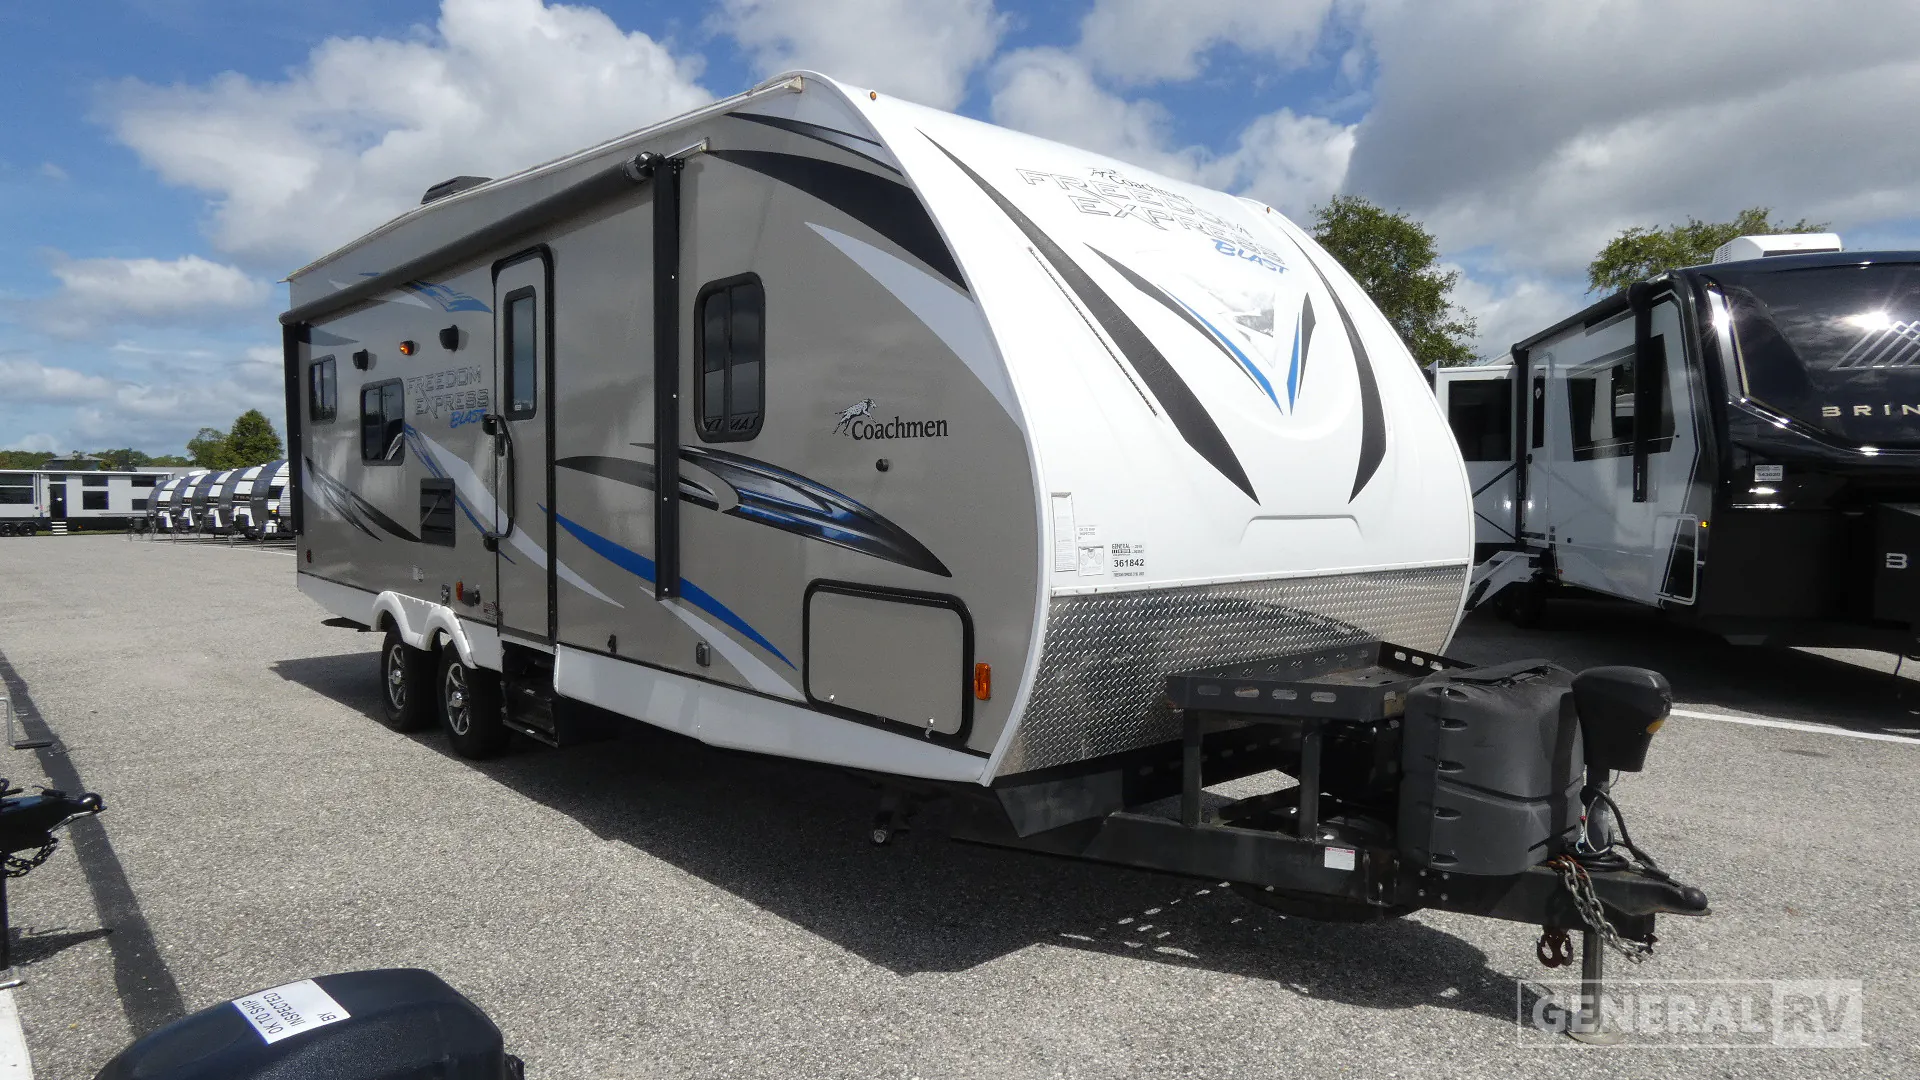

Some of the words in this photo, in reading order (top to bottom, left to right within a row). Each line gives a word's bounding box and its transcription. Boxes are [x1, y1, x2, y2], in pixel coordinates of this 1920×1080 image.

[1015, 168, 1254, 239] FREEDOM
[1067, 195, 1286, 266] EXPRESS
[1210, 238, 1290, 275] BLAST
[406, 365, 482, 395] FREEDOM
[415, 388, 489, 419] EXPRESS
[450, 408, 487, 429] BLAST
[851, 415, 949, 441] Coachmen
[1113, 558, 1145, 568] 361842
[1885, 552, 1908, 570] B
[241, 1000, 265, 1015] SHIP
[254, 1012, 271, 1025] TO
[263, 992, 307, 1027] INSPECTED
[317, 1011, 337, 1022] BY
[263, 1021, 284, 1035] OK
